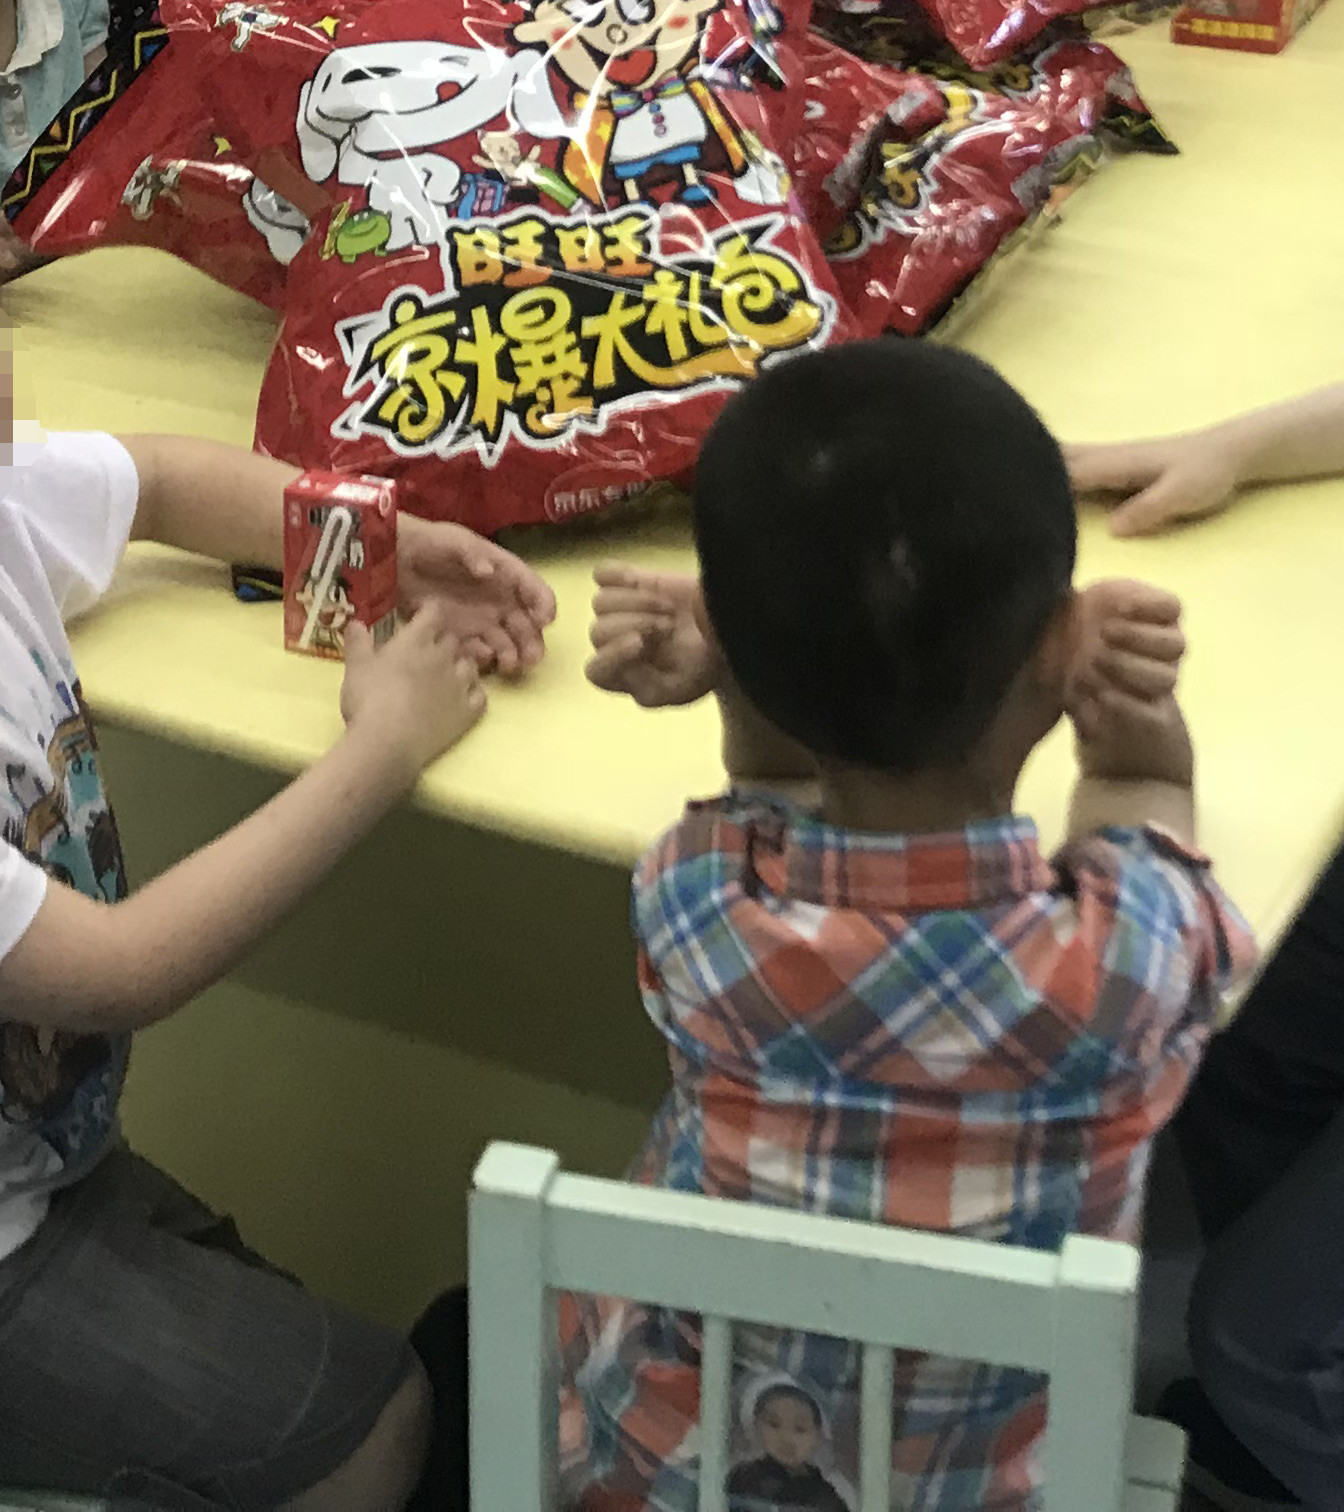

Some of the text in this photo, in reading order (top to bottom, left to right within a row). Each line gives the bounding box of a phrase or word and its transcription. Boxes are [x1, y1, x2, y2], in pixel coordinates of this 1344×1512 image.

[453, 218, 655, 288] 旺旺
[370, 232, 824, 444] 京爆大礼包
